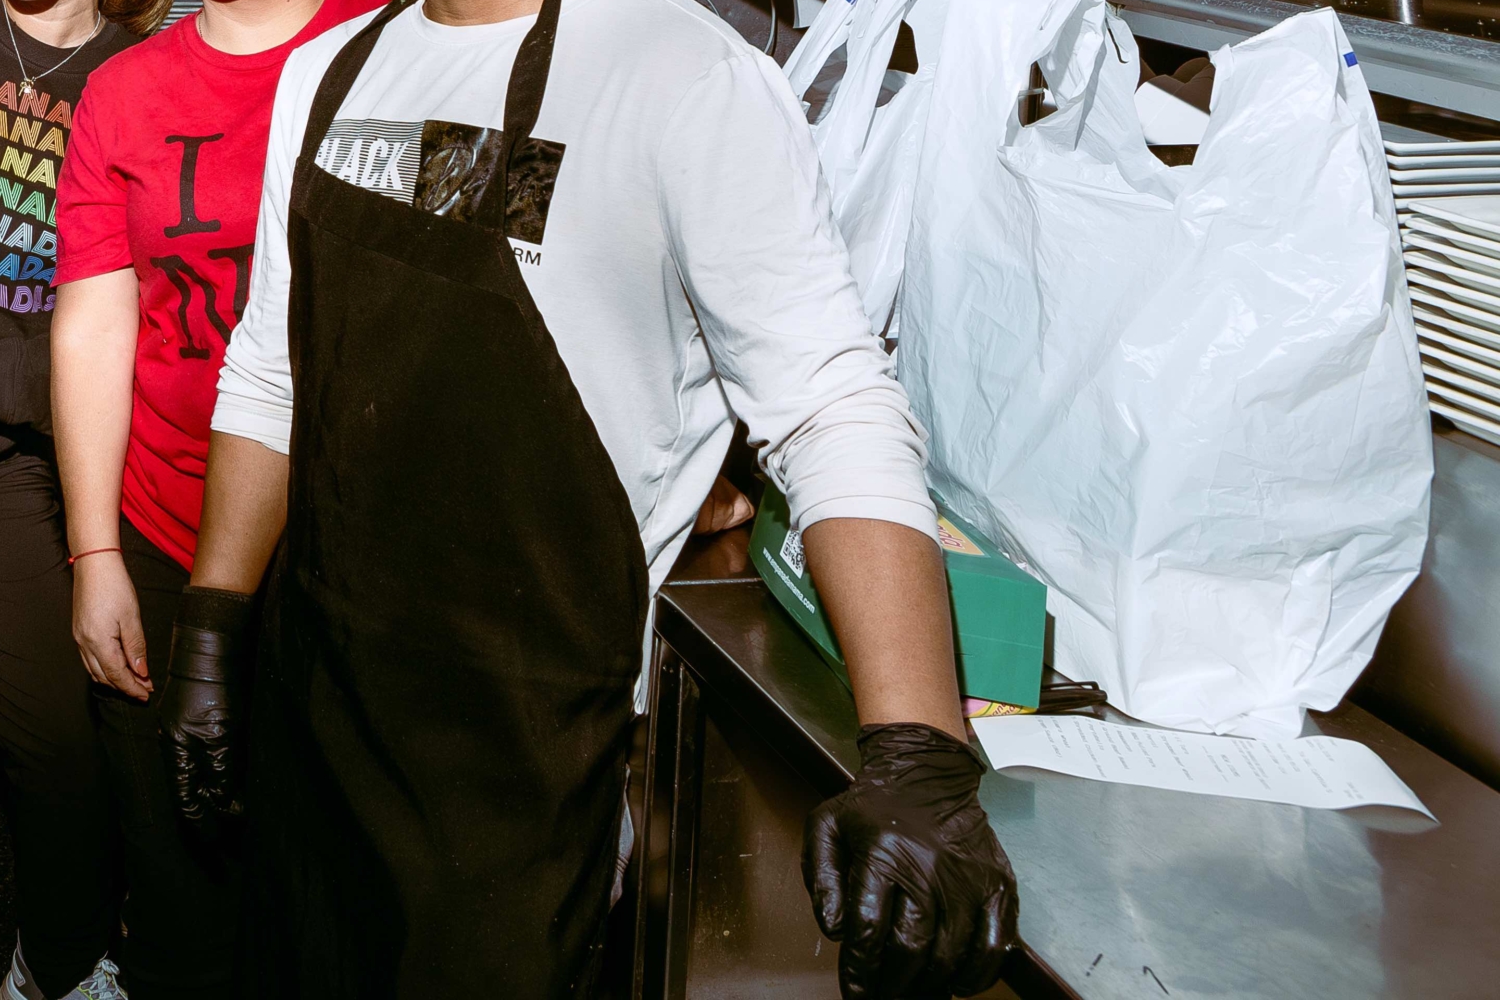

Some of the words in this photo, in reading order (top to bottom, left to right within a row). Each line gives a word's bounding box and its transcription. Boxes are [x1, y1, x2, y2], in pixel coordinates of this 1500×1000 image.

[163, 132, 225, 239] I
[314, 137, 409, 190] LACK
[150, 242, 256, 361] N
[762, 546, 816, 615] www.empanadamama.com
